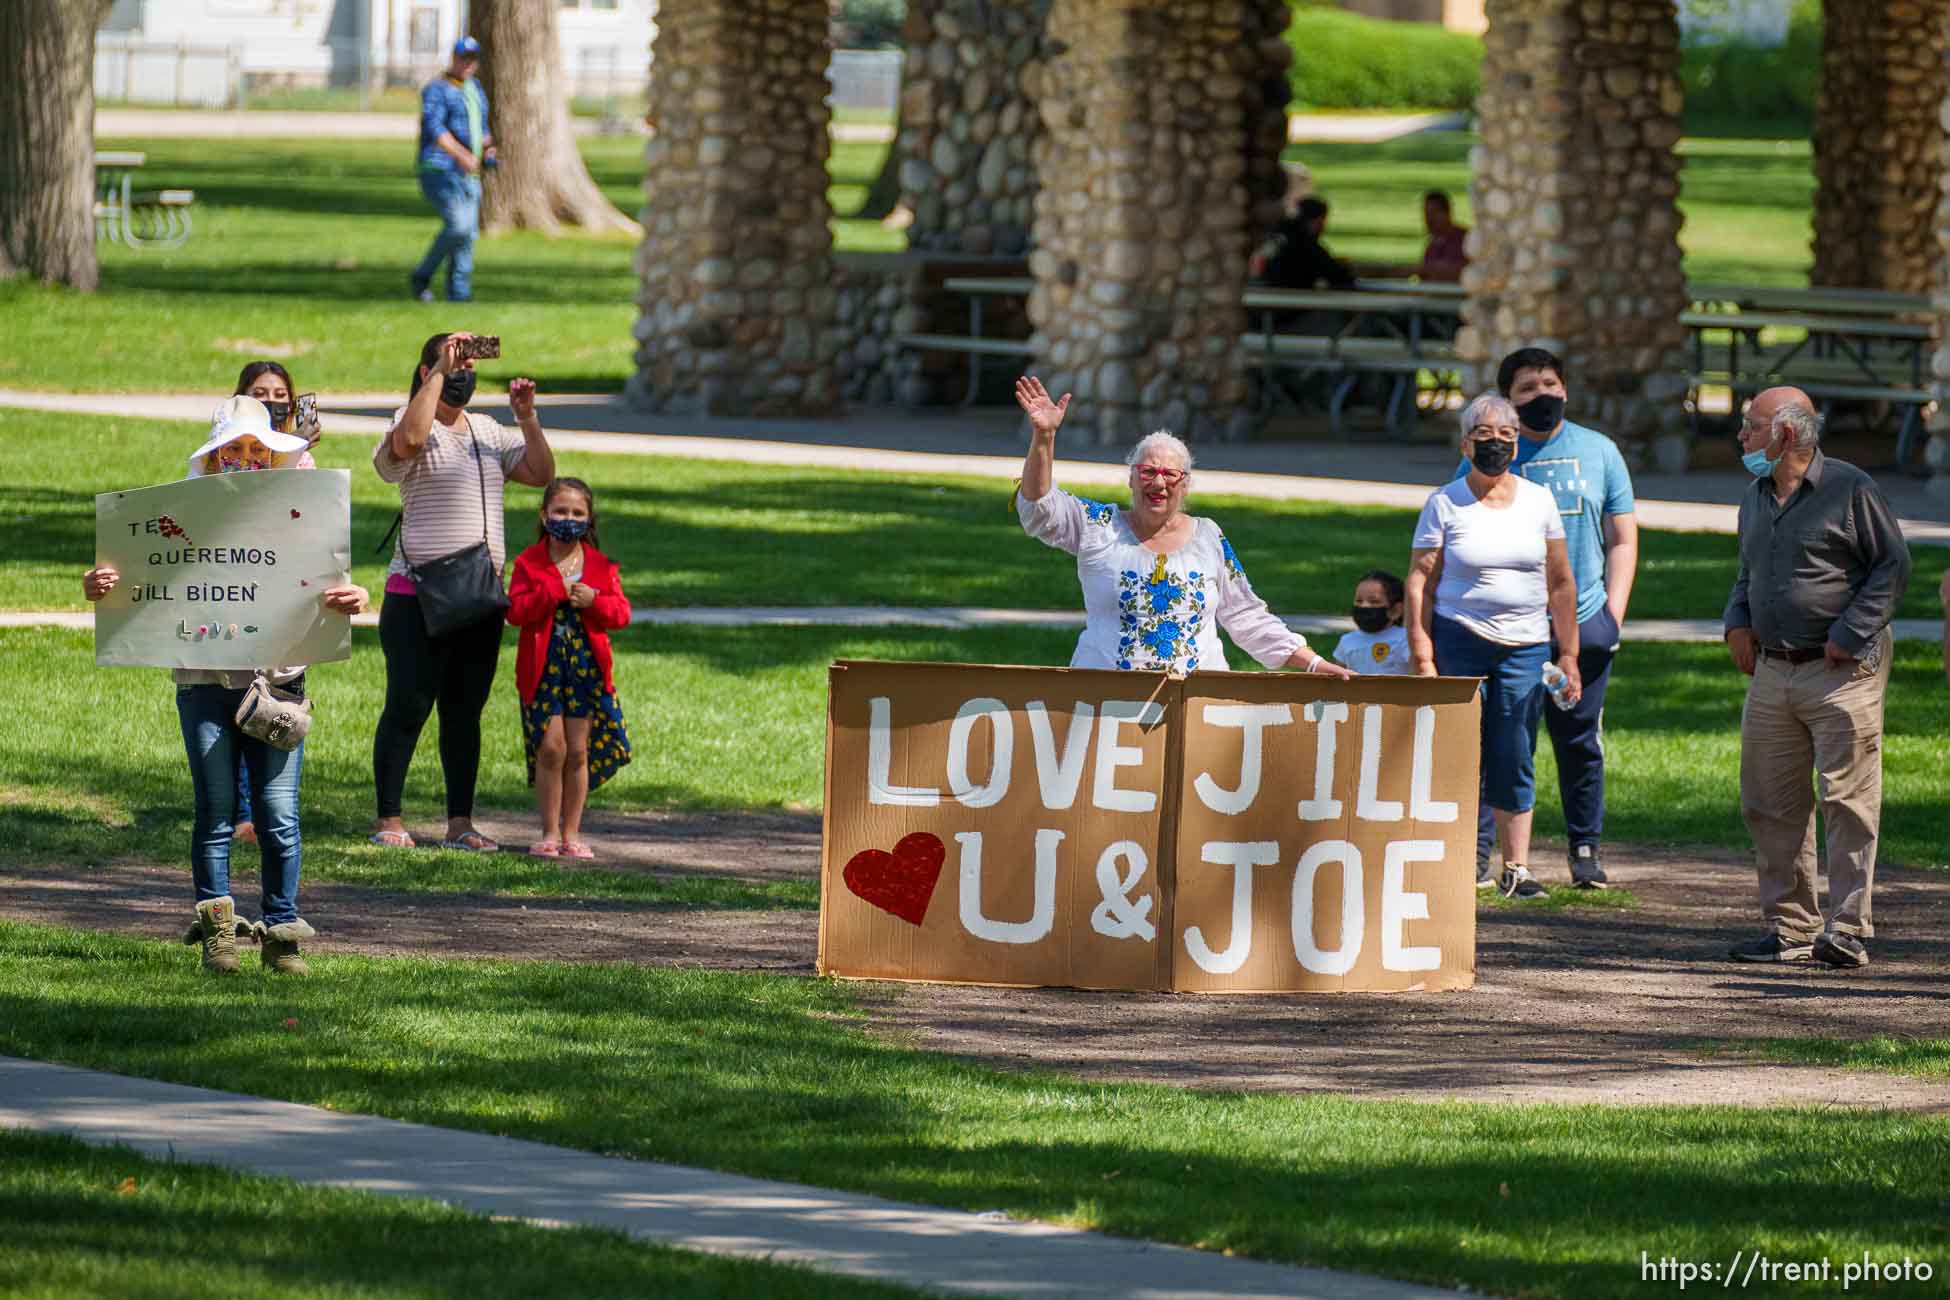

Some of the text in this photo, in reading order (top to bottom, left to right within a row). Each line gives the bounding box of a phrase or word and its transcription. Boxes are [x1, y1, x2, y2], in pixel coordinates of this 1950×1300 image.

[127, 518, 159, 537] TE
[148, 547, 277, 566] QUEREMOS
[867, 696, 1459, 823] LOVE JILL
[954, 828, 1447, 975] U & JOE
